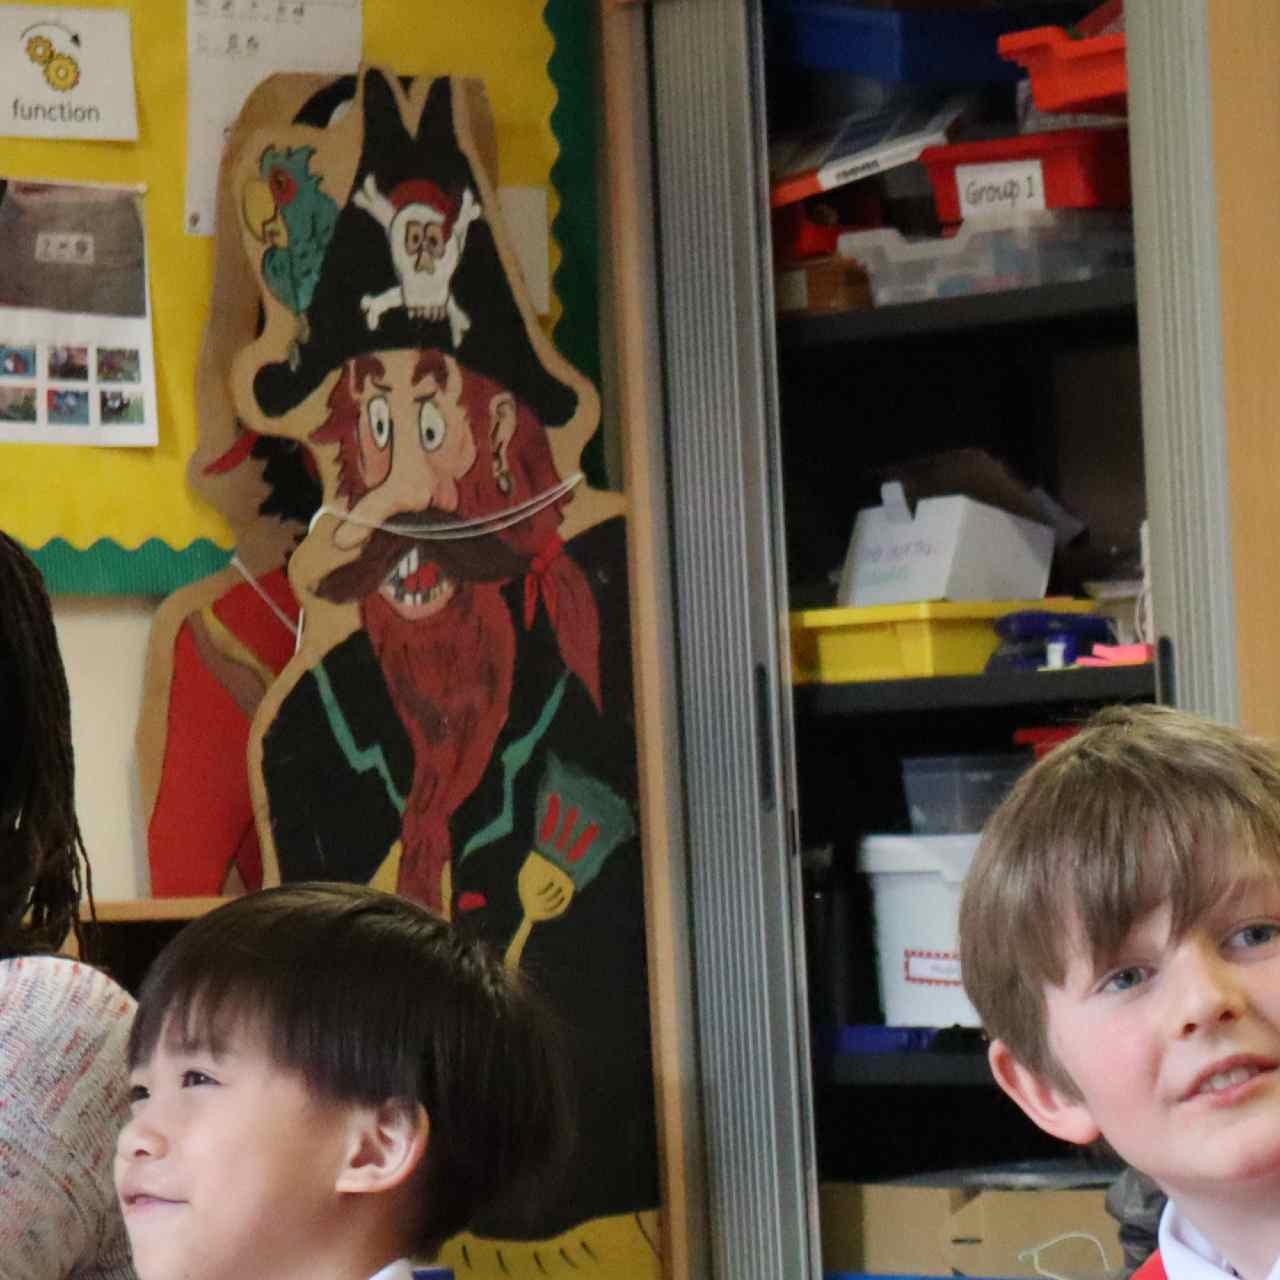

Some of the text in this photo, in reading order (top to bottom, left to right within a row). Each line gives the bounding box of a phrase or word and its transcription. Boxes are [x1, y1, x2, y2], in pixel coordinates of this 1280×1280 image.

[12, 98, 101, 122] function
[966, 175, 1034, 207] Group 1
